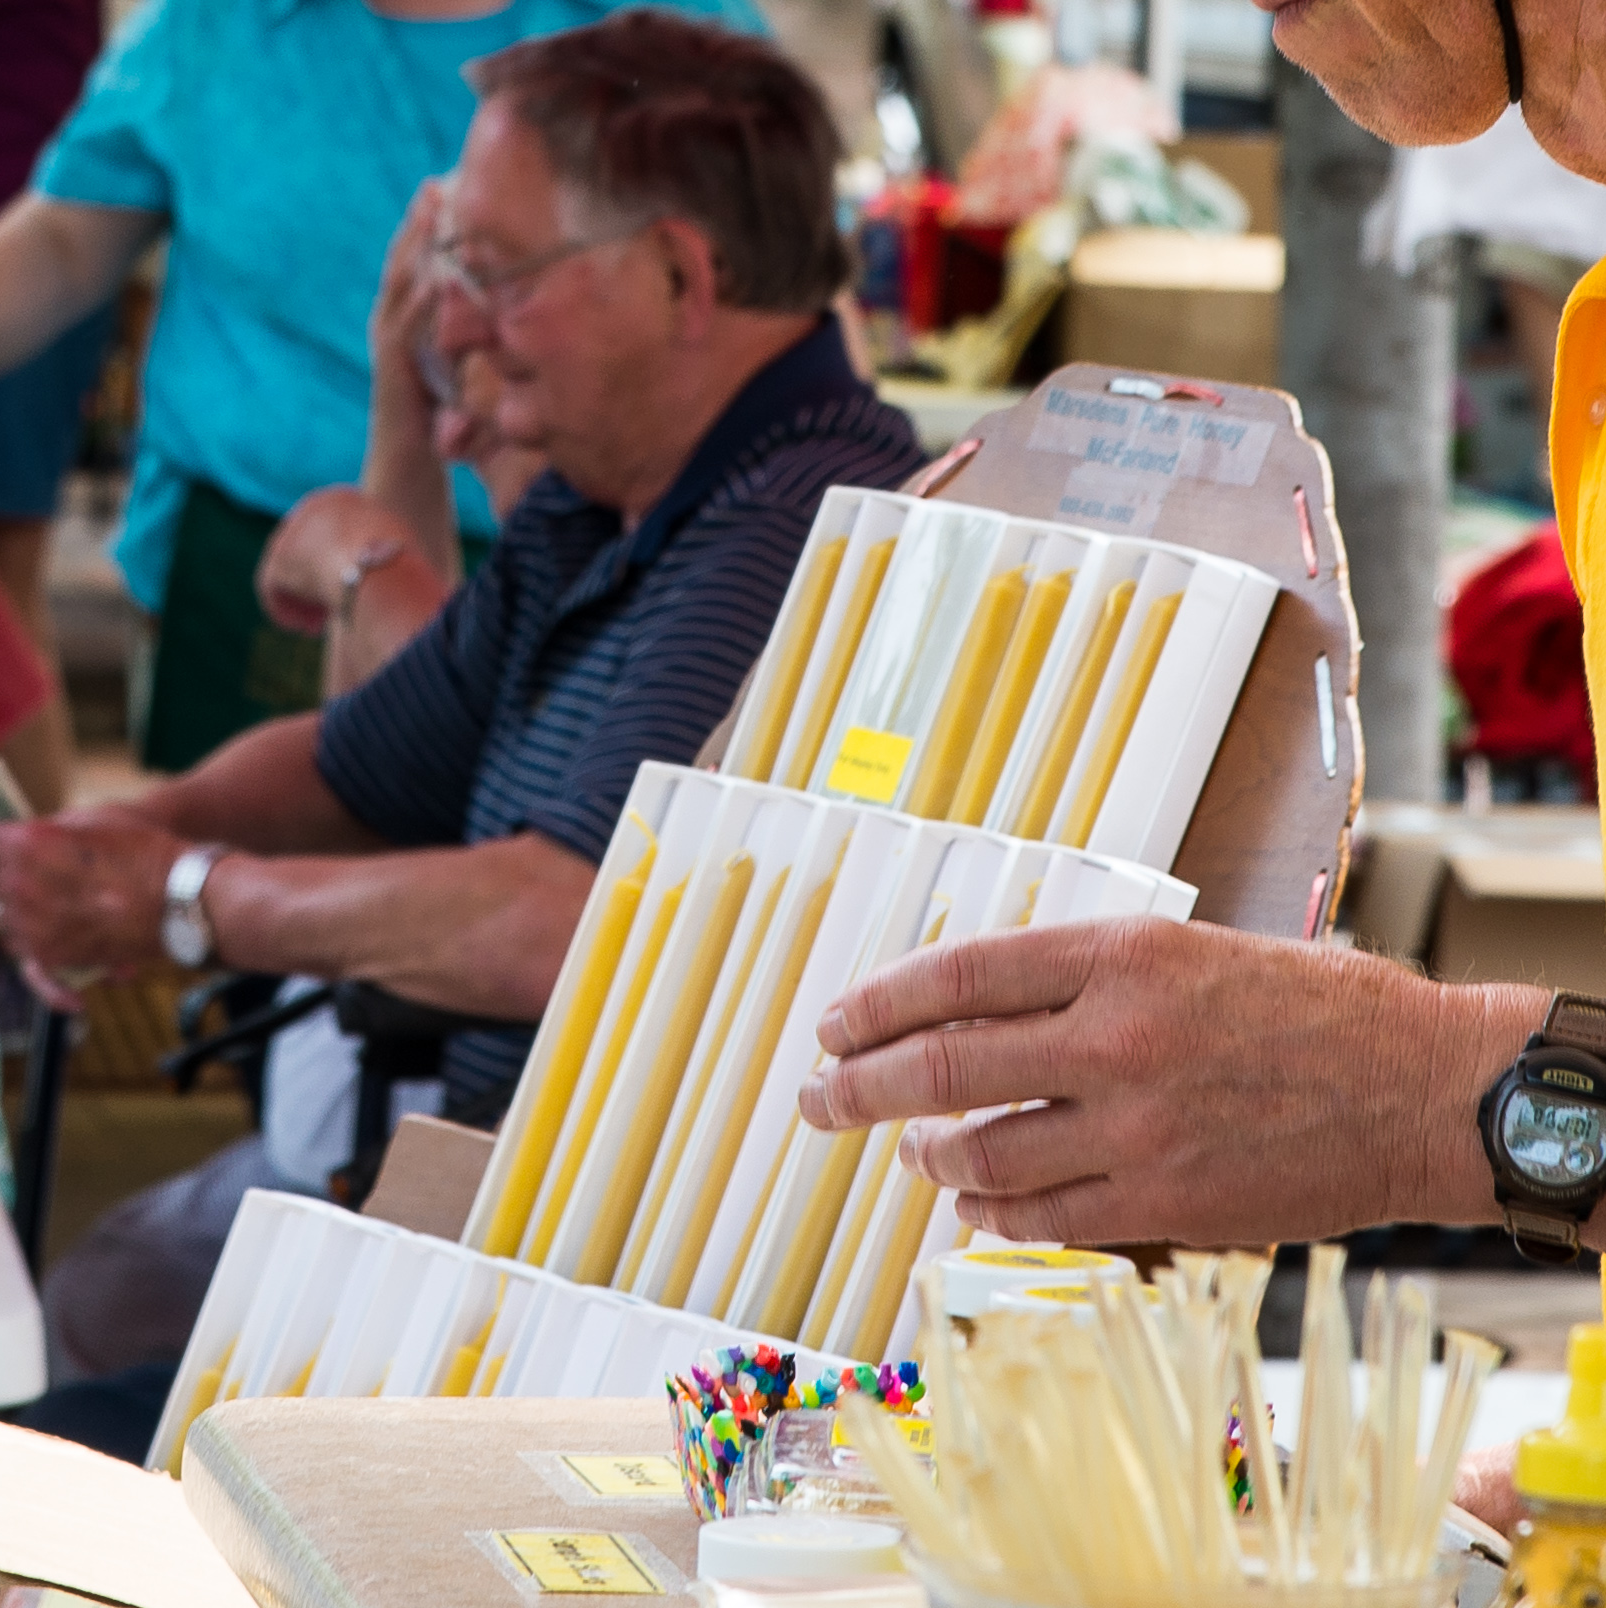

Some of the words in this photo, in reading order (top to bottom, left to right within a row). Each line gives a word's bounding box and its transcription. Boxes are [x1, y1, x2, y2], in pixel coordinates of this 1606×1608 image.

[1140, 404, 1180, 436] Pure
[1188, 414, 1248, 452] Honey
[1084, 437, 1181, 476] McFarland
